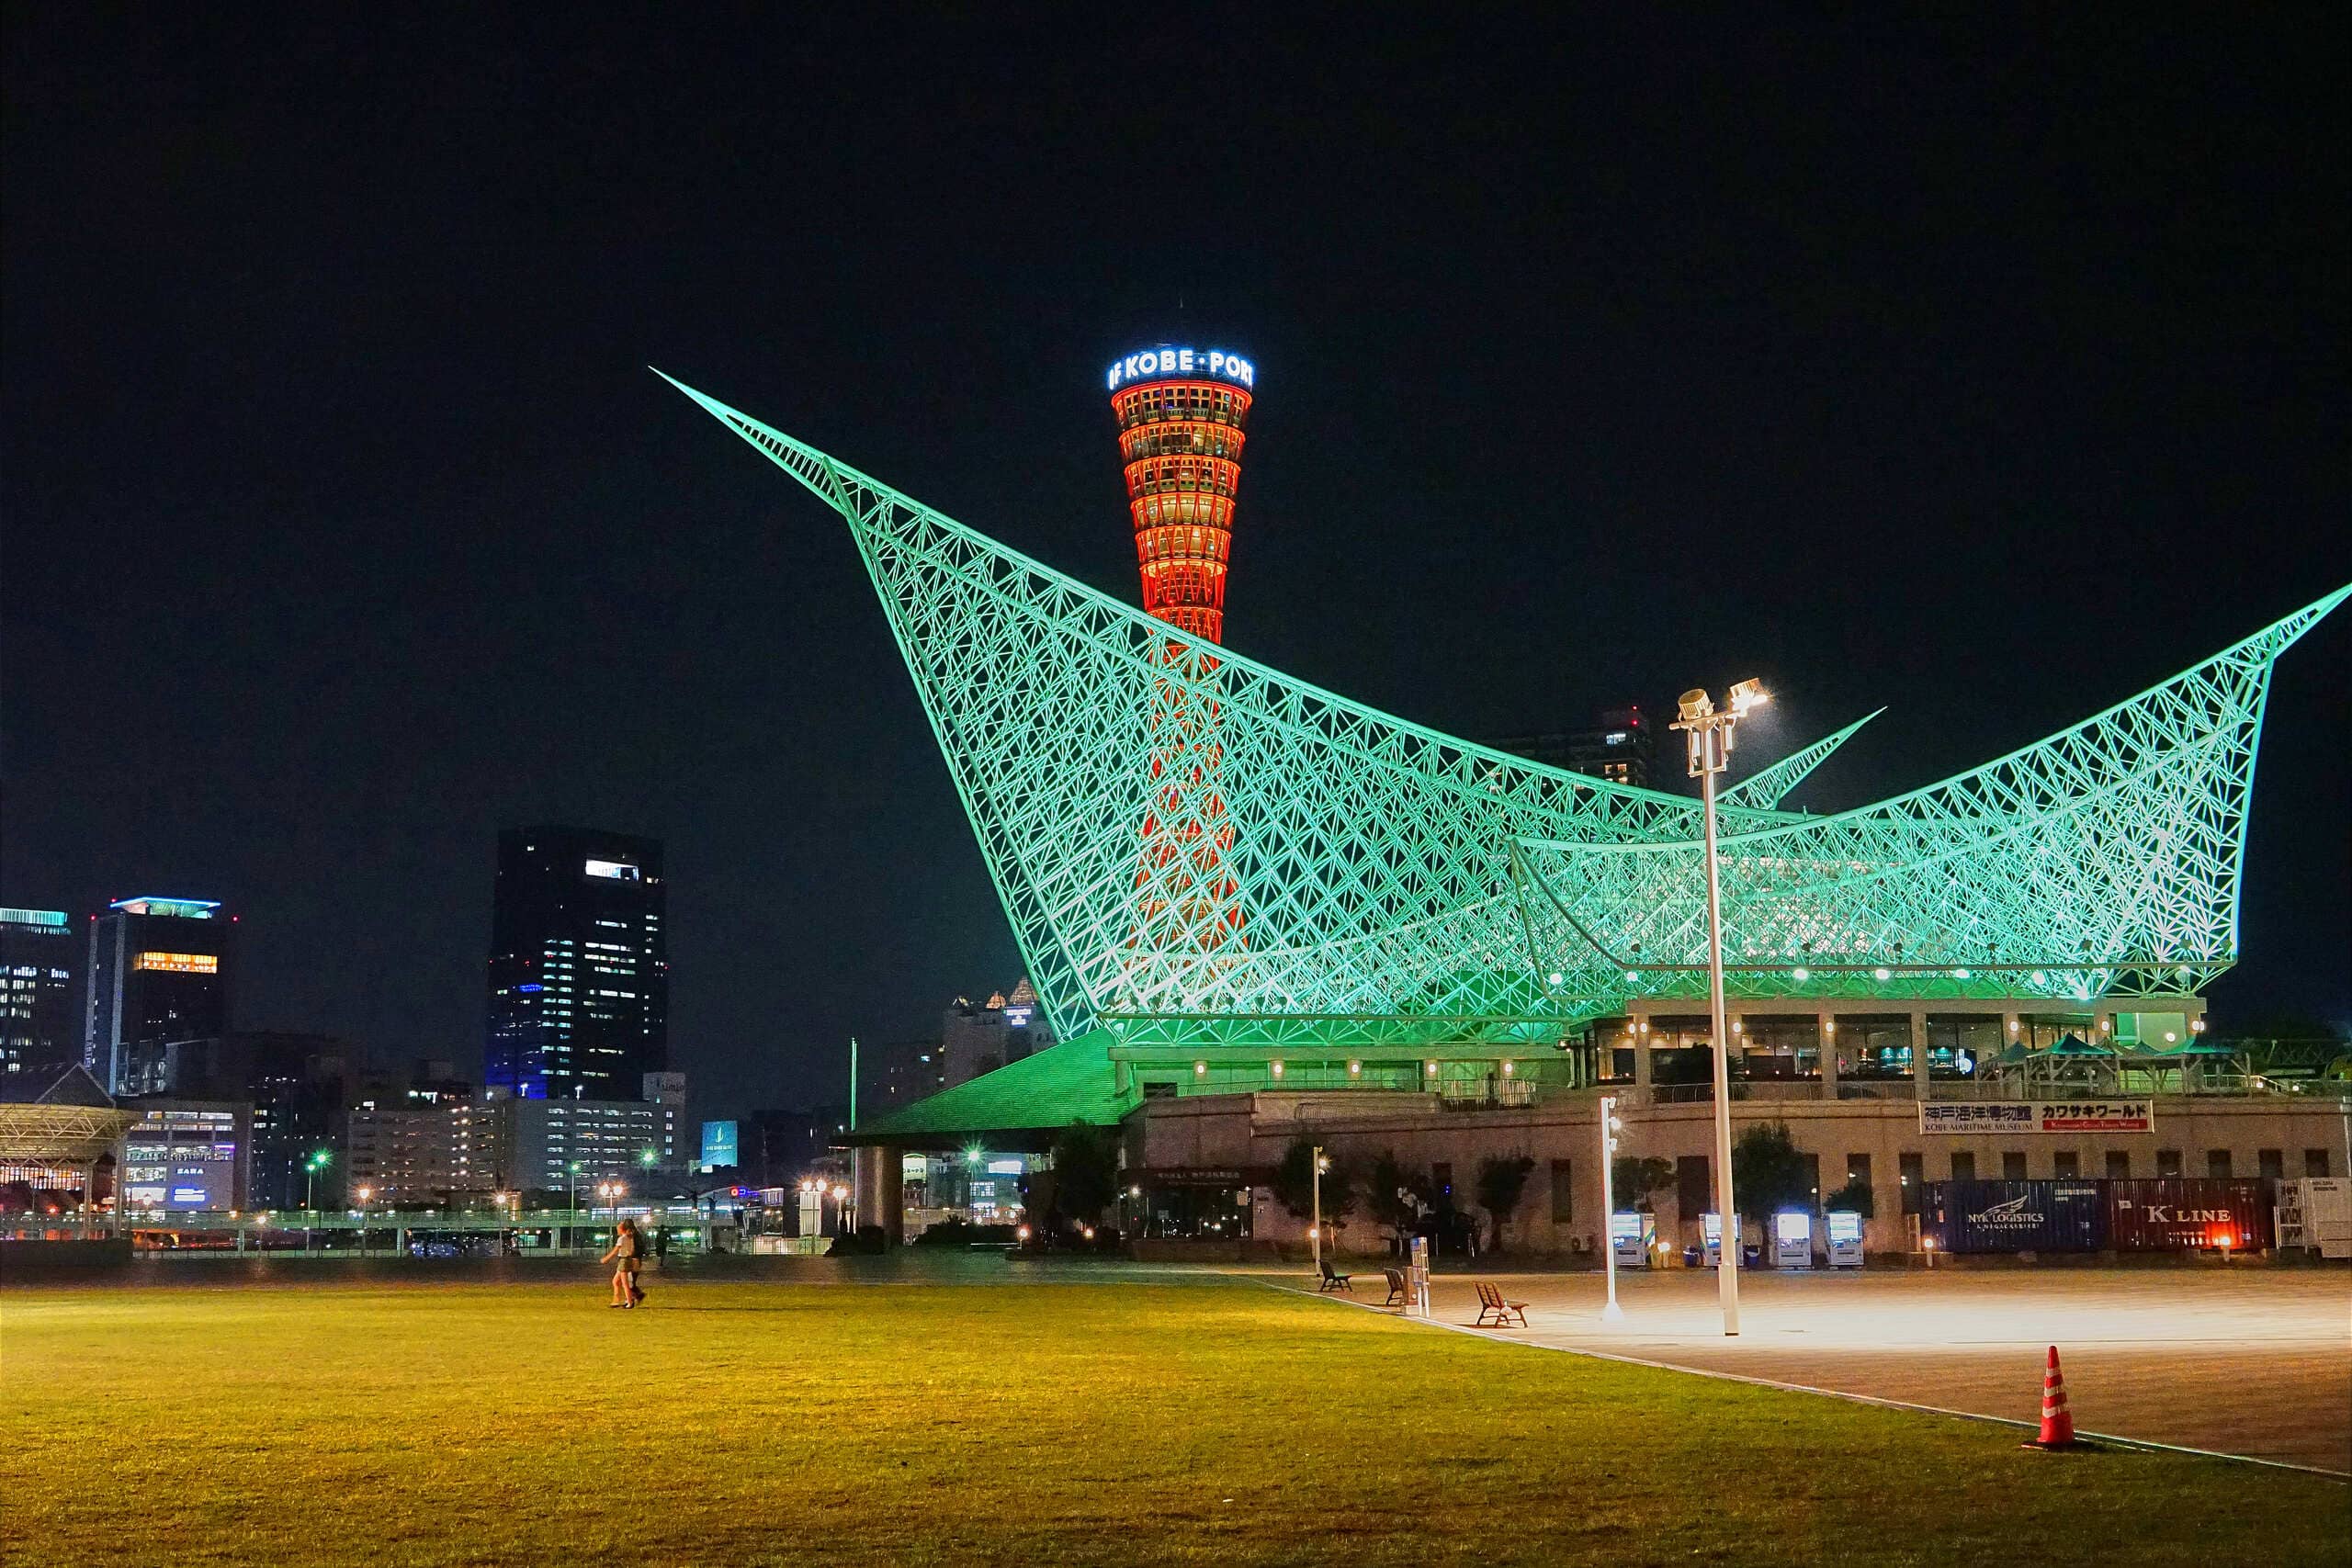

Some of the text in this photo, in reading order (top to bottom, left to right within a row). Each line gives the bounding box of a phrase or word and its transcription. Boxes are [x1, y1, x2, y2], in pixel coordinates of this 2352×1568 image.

[1125, 350, 1193, 378] KOBE
[2042, 1105, 2146, 1118] カワサキワールド
[1950, 1122, 1992, 1131] MARITIME
[1995, 1122, 2033, 1131] MUSEUM
[1968, 1213, 2044, 1223] NYK LOGISTICS
[2176, 1210, 2231, 1223] LINE
